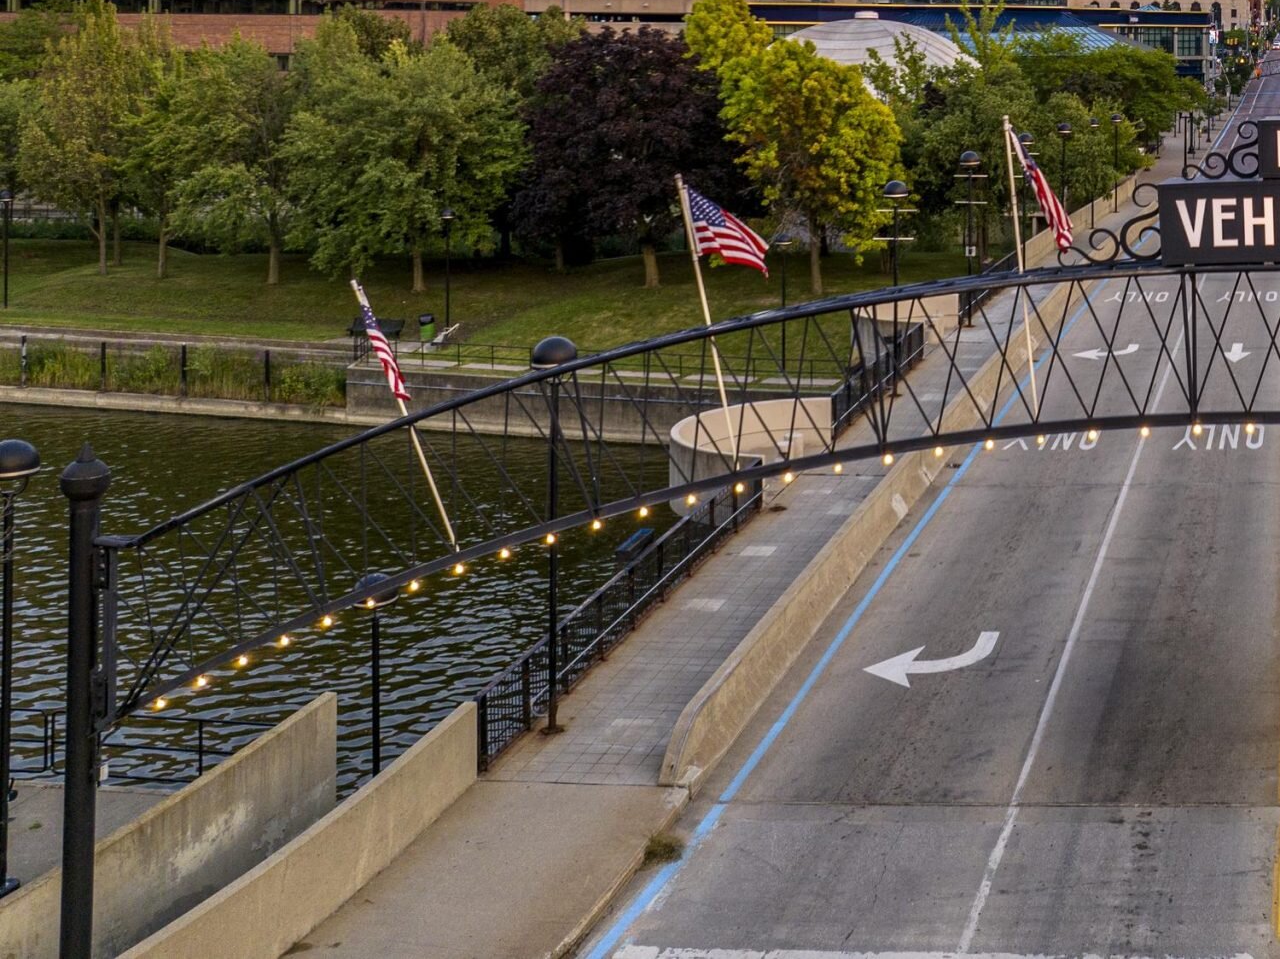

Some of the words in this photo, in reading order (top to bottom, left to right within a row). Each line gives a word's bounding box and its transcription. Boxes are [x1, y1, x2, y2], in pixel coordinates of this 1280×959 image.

[1104, 291, 1169, 302] ONLY
[1216, 291, 1278, 302] ONLY
[1172, 424, 1265, 450] ONLY
